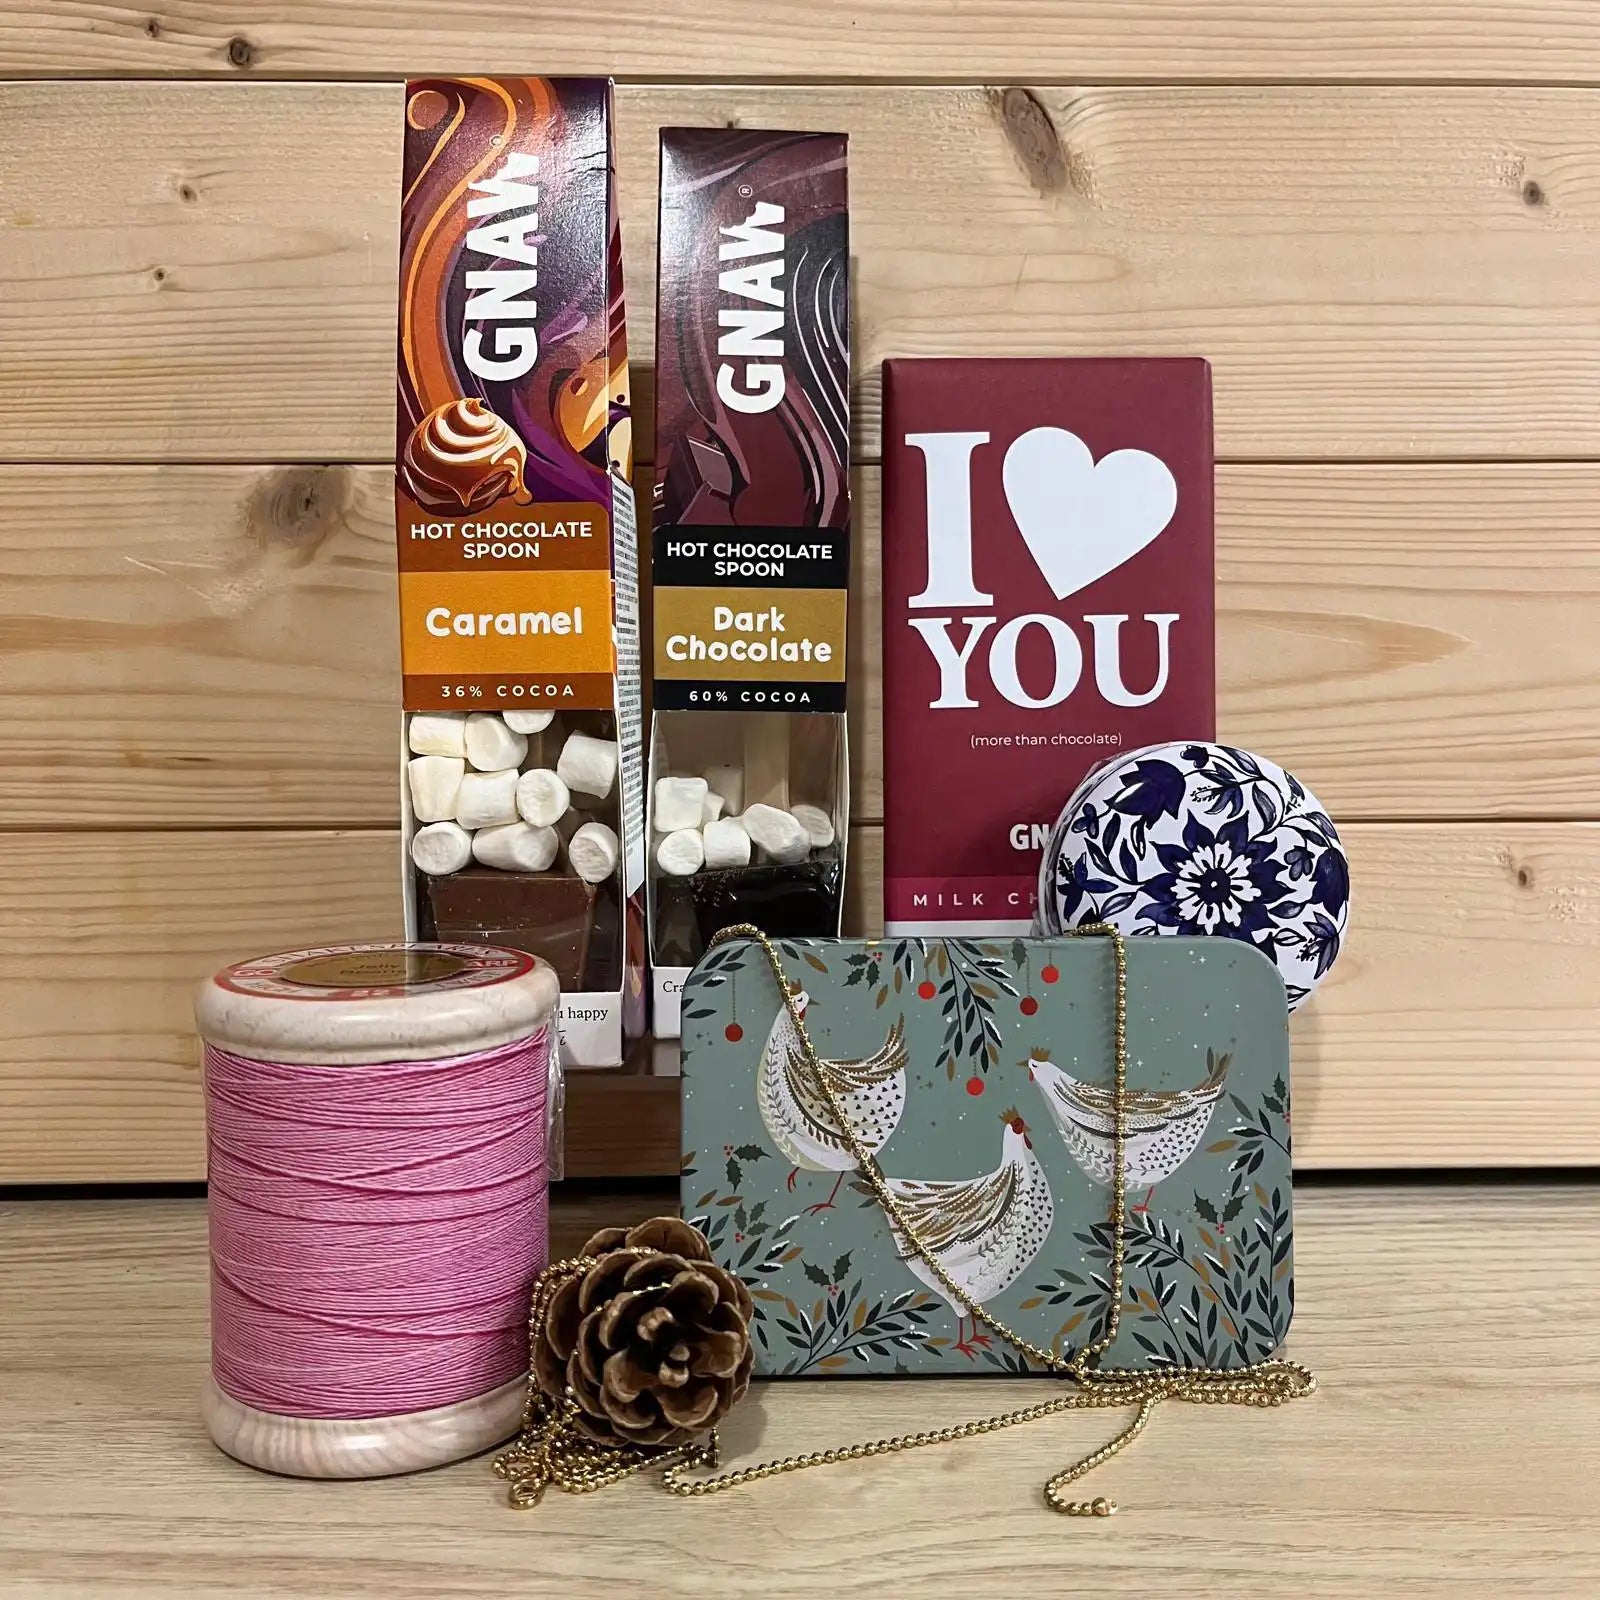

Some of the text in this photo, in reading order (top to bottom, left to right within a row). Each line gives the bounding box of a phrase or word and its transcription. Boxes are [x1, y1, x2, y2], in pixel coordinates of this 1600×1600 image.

[462, 151, 540, 382] GNAW
[716, 200, 786, 414] GNAW
[904, 431, 994, 609] I
[411, 521, 593, 540] HOT CHOCOLATE
[463, 542, 541, 559] SPOON
[667, 541, 833, 560] HOT CHOCOLATE
[714, 561, 785, 577] SPOON
[425, 606, 583, 637] Caramel
[714, 606, 786, 633] Dark
[665, 635, 832, 663] Chocolate
[907, 613, 1180, 709] YOU
[441, 684, 575, 698] 36% COCOA
[689, 690, 811, 703] 60% COCOA
[970, 731, 1123, 749] (more than chocolate)
[913, 893, 984, 907] MILK
[567, 1006, 609, 1022] happy
